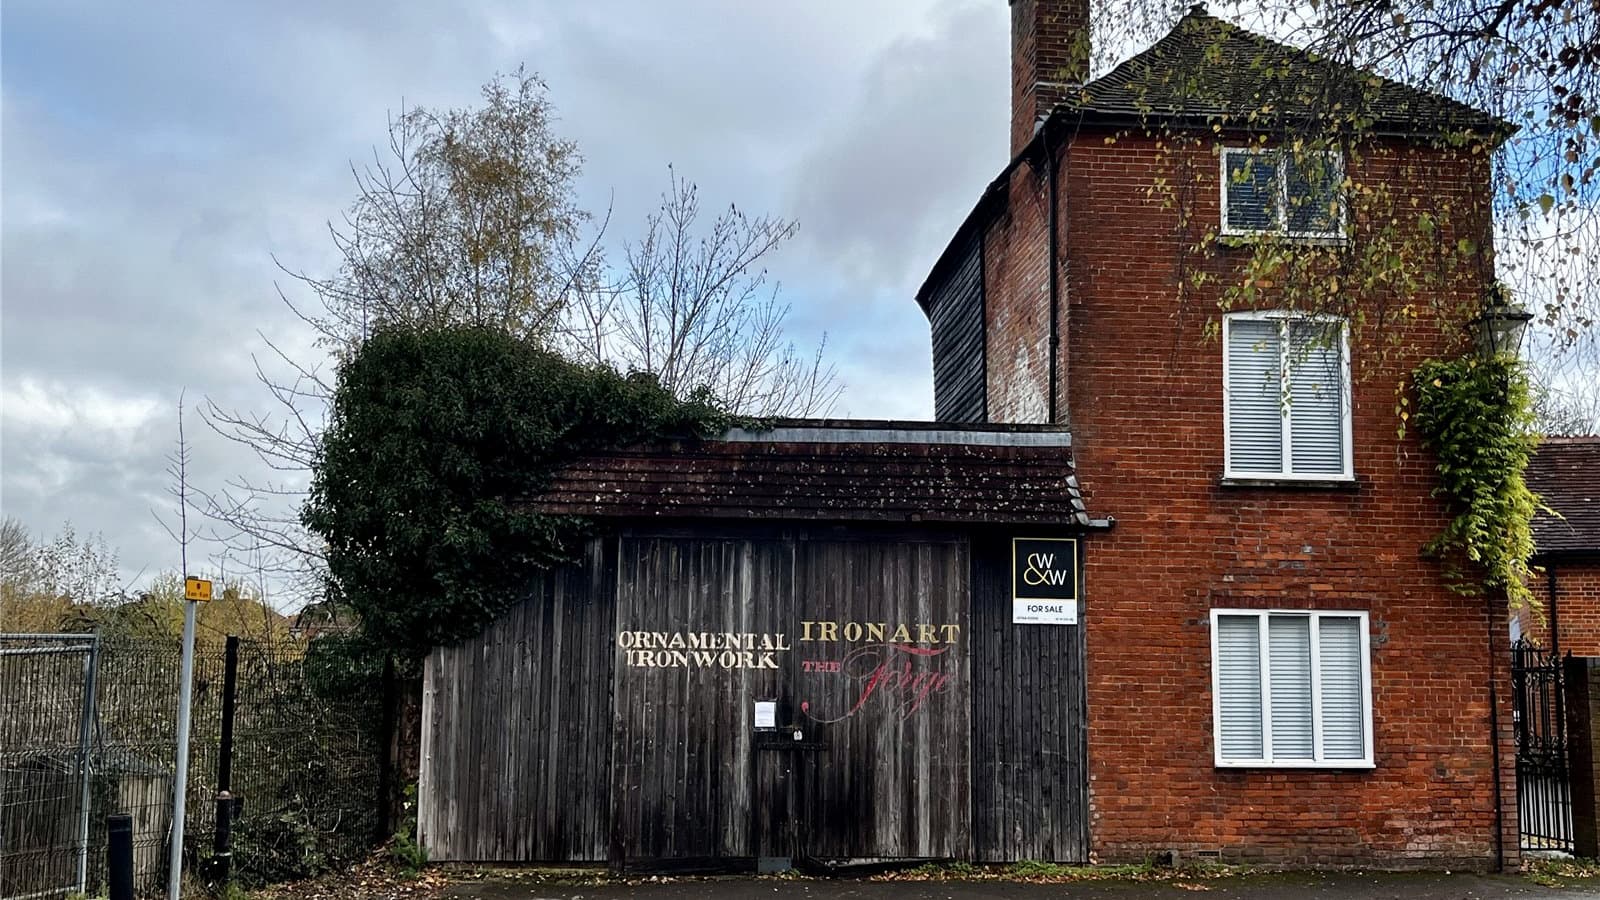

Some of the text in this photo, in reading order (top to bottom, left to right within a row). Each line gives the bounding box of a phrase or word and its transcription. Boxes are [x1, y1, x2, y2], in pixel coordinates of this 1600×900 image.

[1027, 605, 1043, 613] FOR
[618, 630, 791, 651] ORNAMENTAL
[626, 650, 779, 670] IRONWORK
[802, 660, 841, 673] THE
[801, 644, 954, 723] Forge
